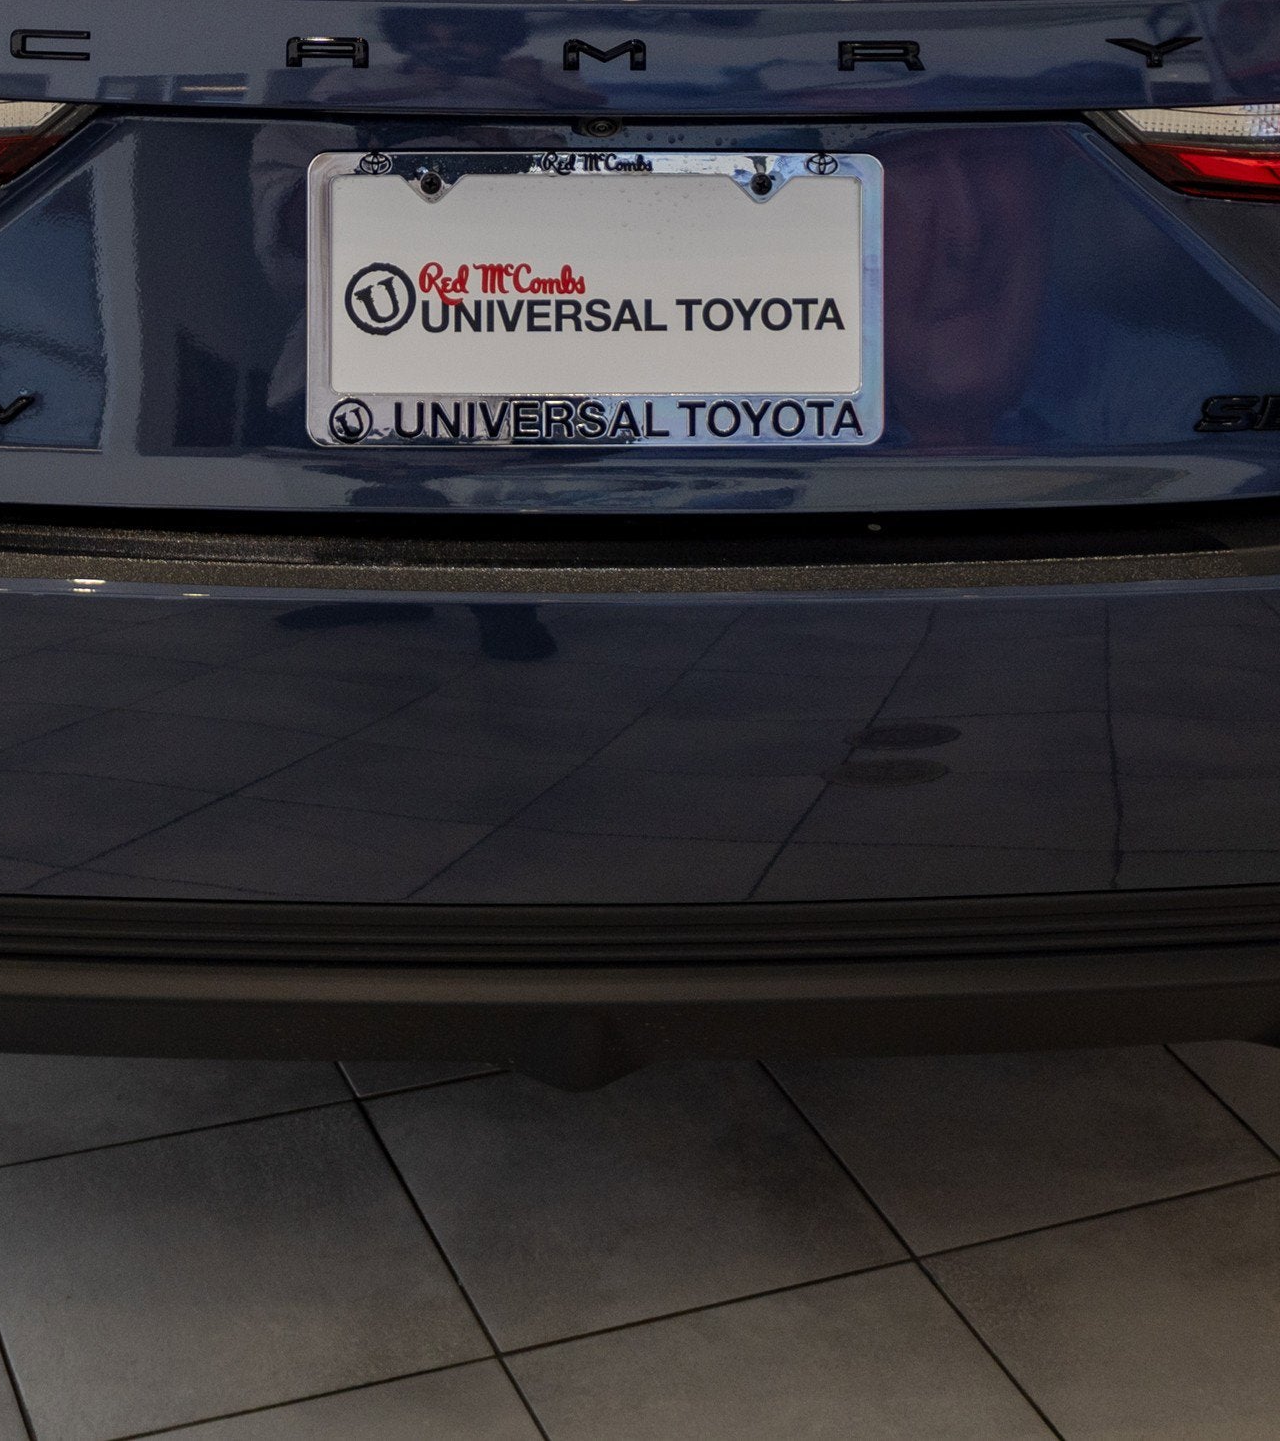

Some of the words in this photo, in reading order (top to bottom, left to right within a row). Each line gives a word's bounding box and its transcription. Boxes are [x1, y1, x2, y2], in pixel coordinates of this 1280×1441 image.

[541, 151, 576, 175] Red
[580, 153, 653, 173] McCombs
[419, 261, 470, 306] Red
[472, 261, 586, 296] McCombs
[422, 298, 668, 334] UNIVERSAL
[676, 297, 846, 333] TOYOTA
[394, 399, 670, 439] UNIVERSAL
[677, 399, 865, 438] TOYOTA
